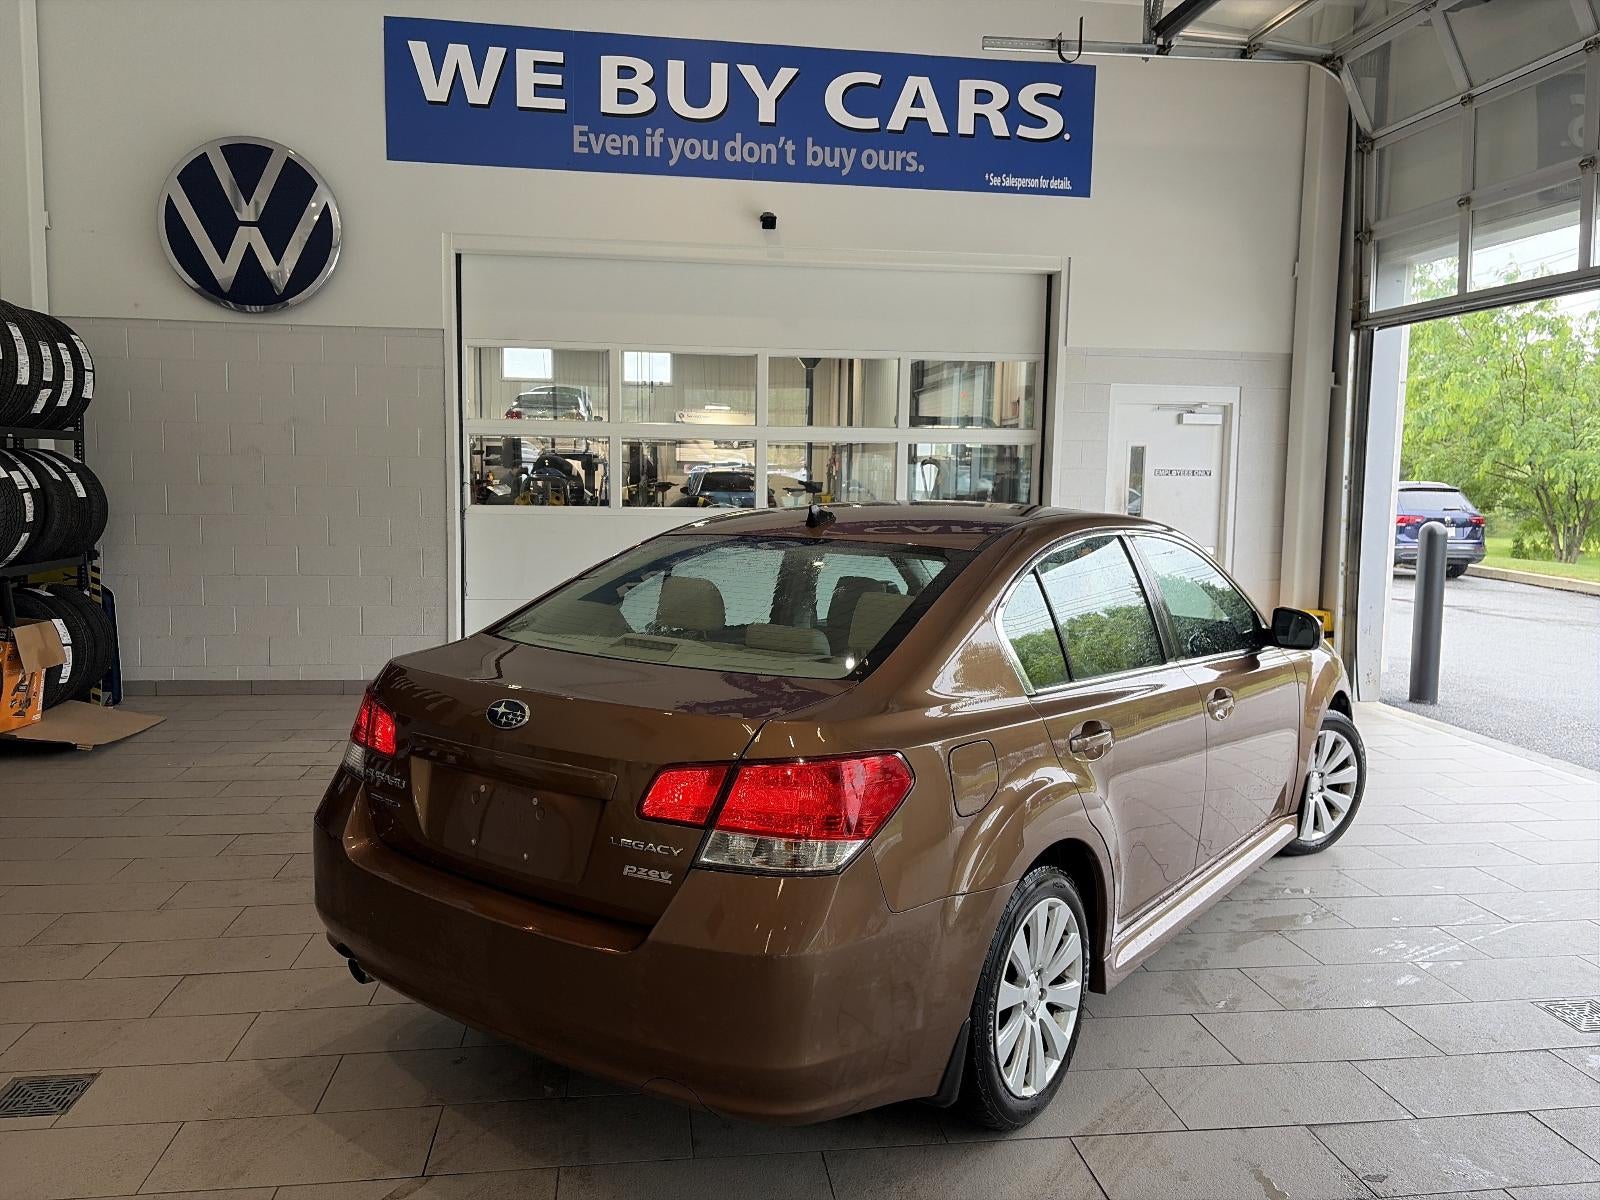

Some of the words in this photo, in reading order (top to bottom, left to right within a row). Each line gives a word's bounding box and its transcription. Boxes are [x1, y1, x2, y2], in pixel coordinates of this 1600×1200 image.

[407, 40, 566, 111] WE
[600, 55, 800, 124] BUY
[824, 71, 1071, 141] CARS.
[573, 125, 639, 156] Even
[645, 127, 665, 157] if
[668, 137, 719, 167] you
[724, 133, 796, 166] don't
[806, 137, 857, 176] buy
[861, 148, 925, 173] ours.
[989, 172, 1001, 186] See
[1002, 173, 1039, 190] Salesperson
[1039, 175, 1050, 189] for
[1050, 176, 1073, 190] details.
[1155, 469, 1193, 477] EMPLOYEES
[1194, 469, 1212, 477] ONLY
[610, 836, 684, 856] LEGACY
